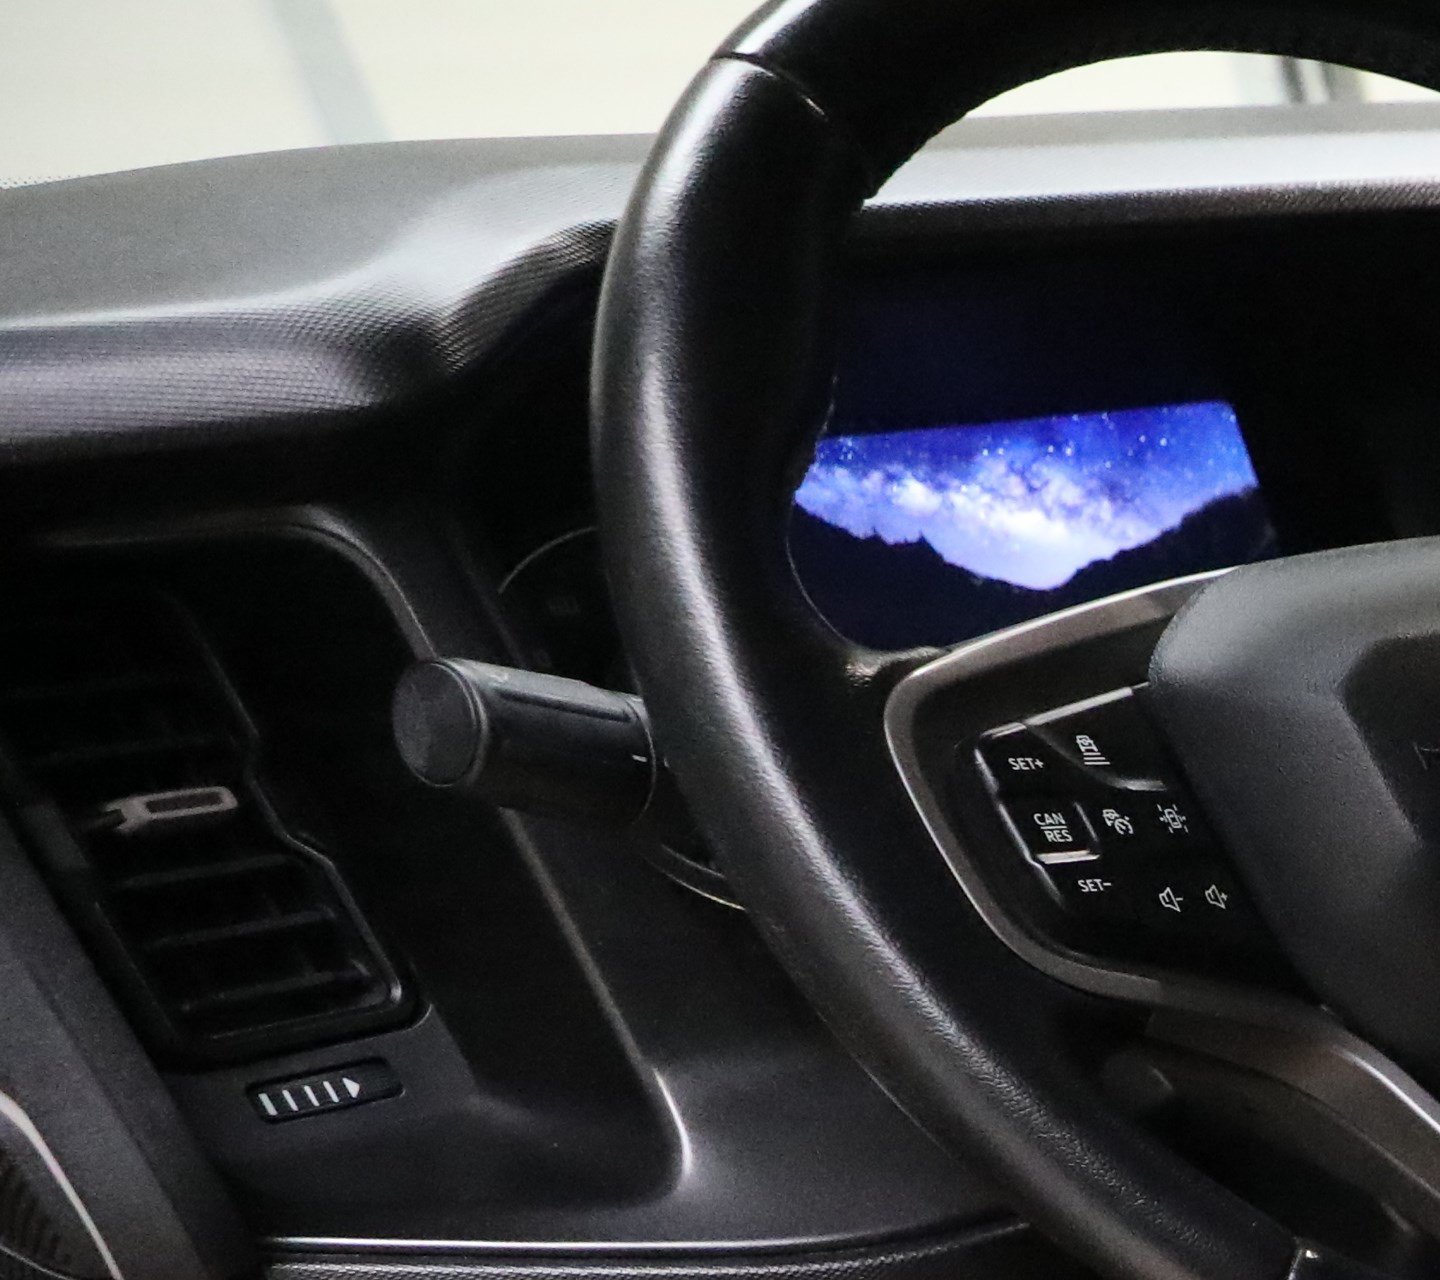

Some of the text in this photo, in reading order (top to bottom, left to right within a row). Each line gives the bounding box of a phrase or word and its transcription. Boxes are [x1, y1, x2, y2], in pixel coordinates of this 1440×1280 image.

[1007, 756, 1045, 772] SET+
[1032, 811, 1067, 827] CAN
[1043, 829, 1074, 843] RES
